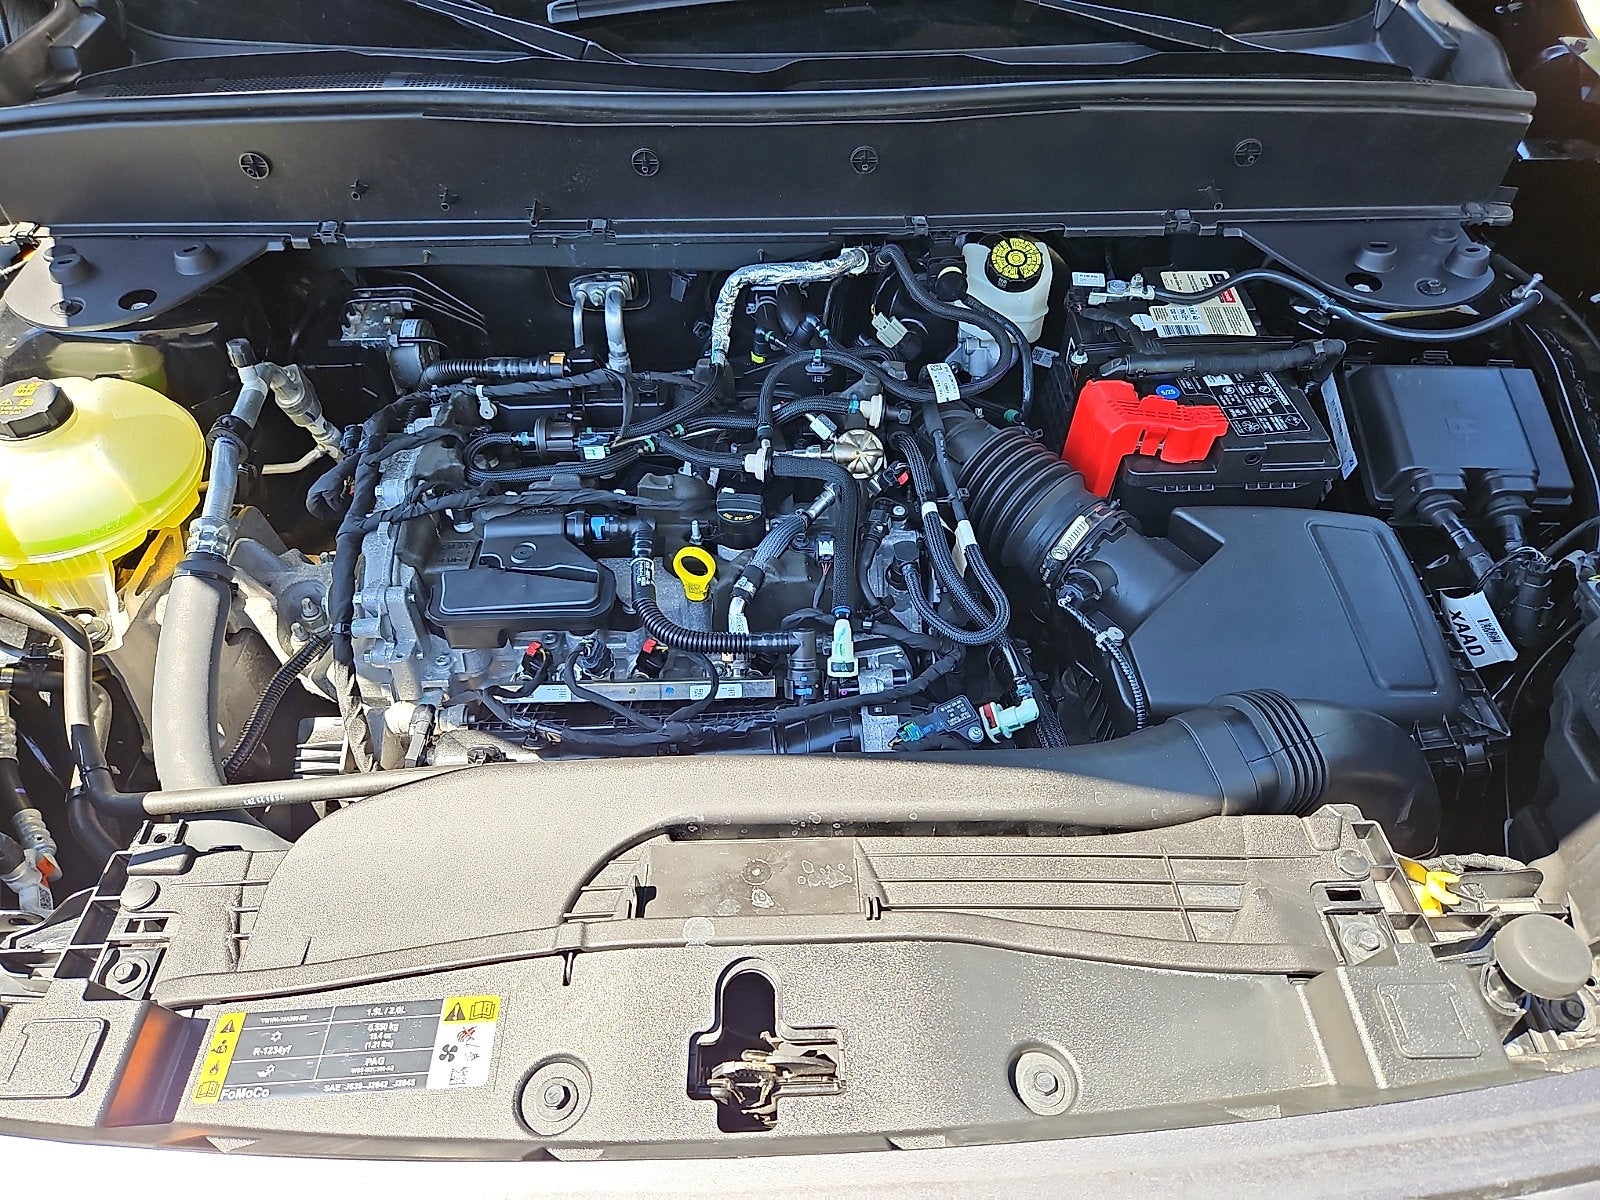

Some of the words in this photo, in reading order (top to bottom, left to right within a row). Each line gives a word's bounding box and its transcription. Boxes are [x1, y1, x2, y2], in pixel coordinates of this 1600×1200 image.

[1448, 608, 1486, 657] XAAD
[252, 1044, 293, 1056] R-1234yf
[365, 1057, 385, 1066] PAG
[220, 1086, 270, 1100] FoMoCo
[323, 1084, 341, 1092] SAE
